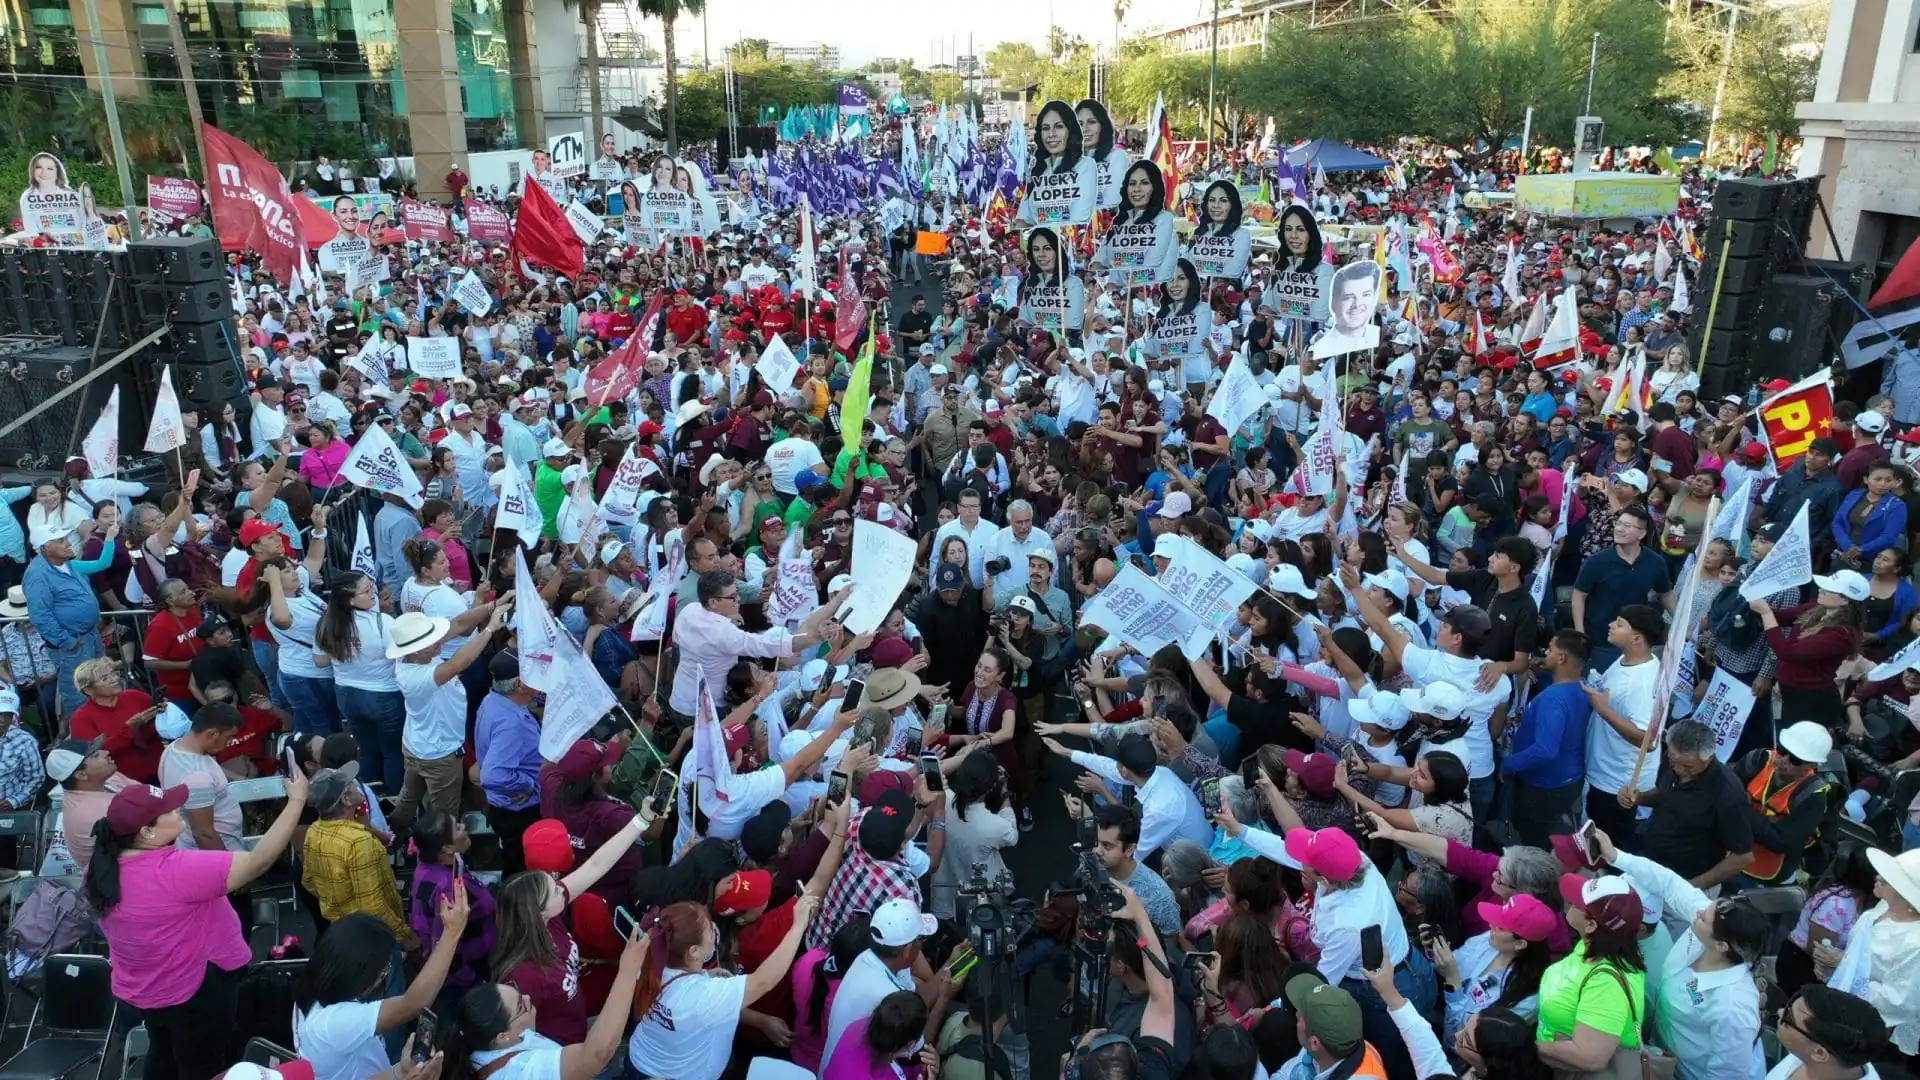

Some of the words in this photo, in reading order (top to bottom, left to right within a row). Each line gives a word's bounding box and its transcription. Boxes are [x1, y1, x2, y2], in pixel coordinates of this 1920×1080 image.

[843, 84, 862, 96] PES
[552, 136, 583, 164] CTM
[1033, 172, 1079, 188] VICKY
[149, 183, 197, 196] CLAUDIA
[222, 187, 237, 197] La
[1033, 187, 1081, 202] LOPEZ
[27, 191, 80, 204] GLORIA
[646, 192, 687, 201] GLORIA
[29, 201, 81, 210] CONTRERAS
[1037, 205, 1069, 213] morena
[40, 213, 74, 221] morena
[571, 208, 600, 235] morena
[1113, 223, 1157, 235] VICKY
[330, 241, 367, 250] CLAUDIA
[1112, 236, 1157, 248] LOPEZ
[1195, 236, 1236, 247] VICKY
[1113, 251, 1145, 259] morena
[1194, 247, 1236, 258] LOPEZ
[1277, 271, 1318, 286] VICKY
[1030, 286, 1069, 297] VICKY
[1277, 283, 1320, 299] LOPEZ
[1031, 298, 1072, 309] LOPEZ
[1280, 299, 1309, 309] morena
[1157, 315, 1197, 328] VICKY
[1157, 326, 1198, 340] LOPEZ
[1763, 399, 1817, 460] PT
[1715, 702, 1732, 735] ORTI
[1716, 705, 1738, 747] OSCAR
